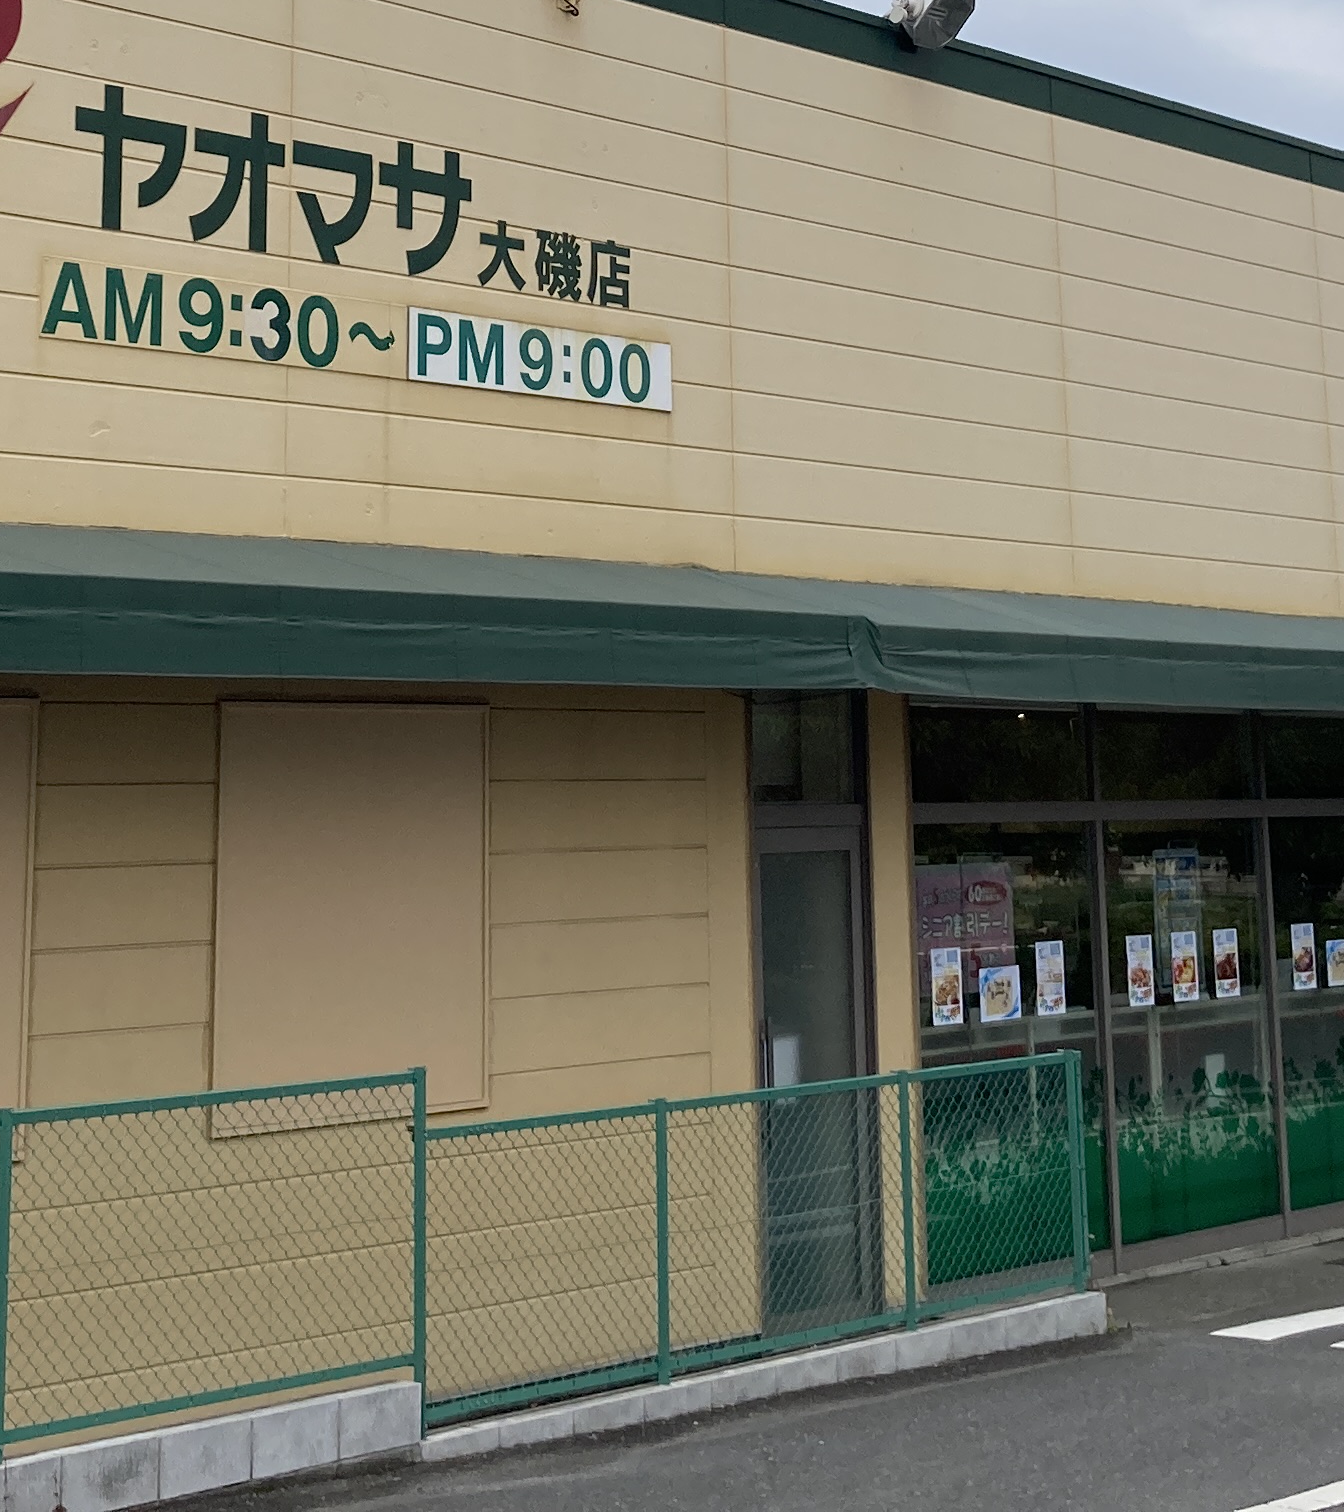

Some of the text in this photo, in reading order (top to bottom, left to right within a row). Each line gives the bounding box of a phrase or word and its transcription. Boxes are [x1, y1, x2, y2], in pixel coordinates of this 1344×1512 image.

[74, 84, 631, 309] ヤオマサ 大磯店
